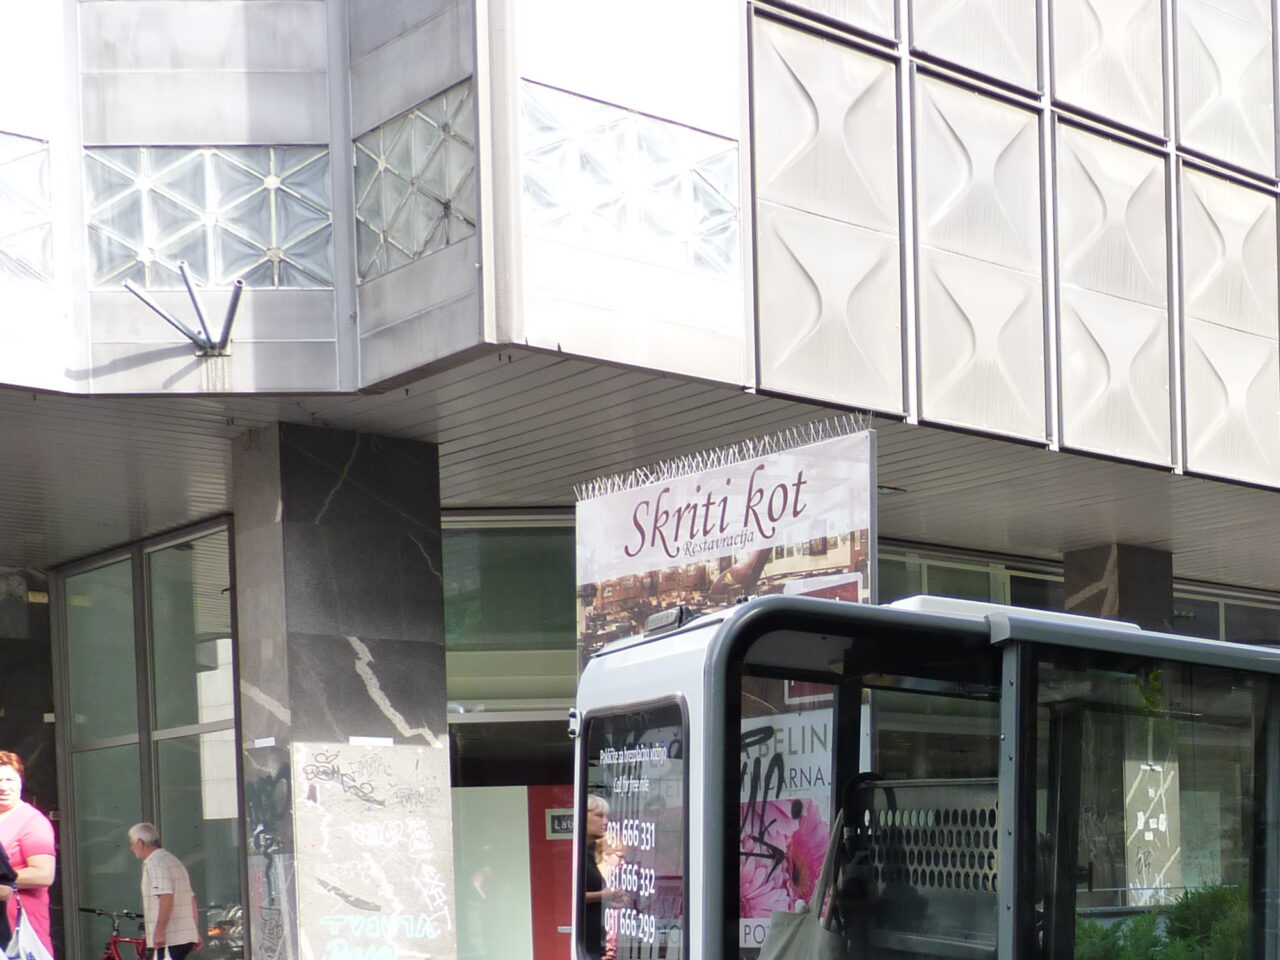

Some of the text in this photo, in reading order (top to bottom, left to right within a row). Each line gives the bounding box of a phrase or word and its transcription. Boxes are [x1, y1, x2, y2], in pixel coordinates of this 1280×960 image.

[624, 463, 808, 558] Skriti kot
[682, 530, 755, 556] Restavracija
[606, 819, 655, 850] 031 666 331
[605, 864, 655, 896] 031 666 332
[604, 908, 618, 934] 031
[620, 908, 637, 936] 666
[638, 912, 655, 944] 299
